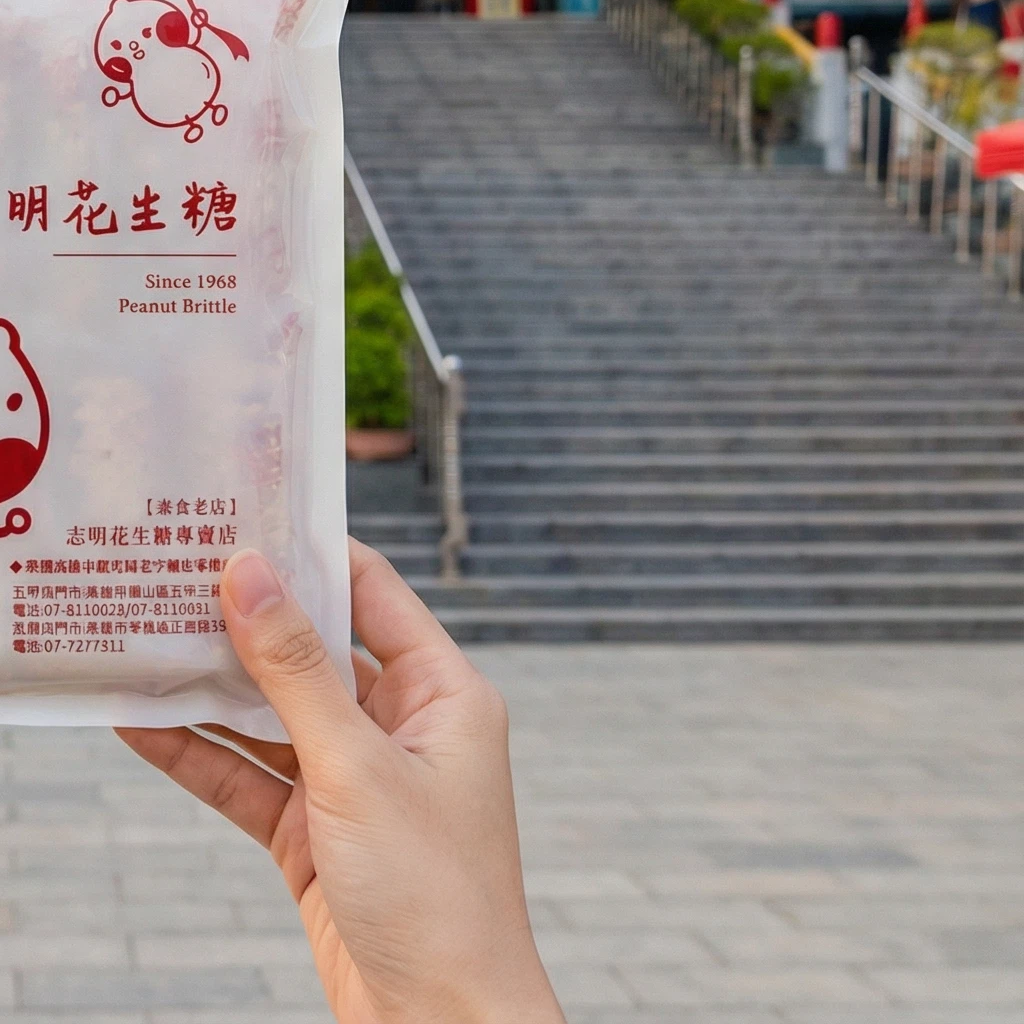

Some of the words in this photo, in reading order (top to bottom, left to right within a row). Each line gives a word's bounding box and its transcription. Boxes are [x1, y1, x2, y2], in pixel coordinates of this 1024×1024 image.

[145, 274, 191, 289] Since
[198, 274, 237, 289] 1968
[119, 298, 177, 313] Peanut
[182, 298, 236, 314] Brittle
